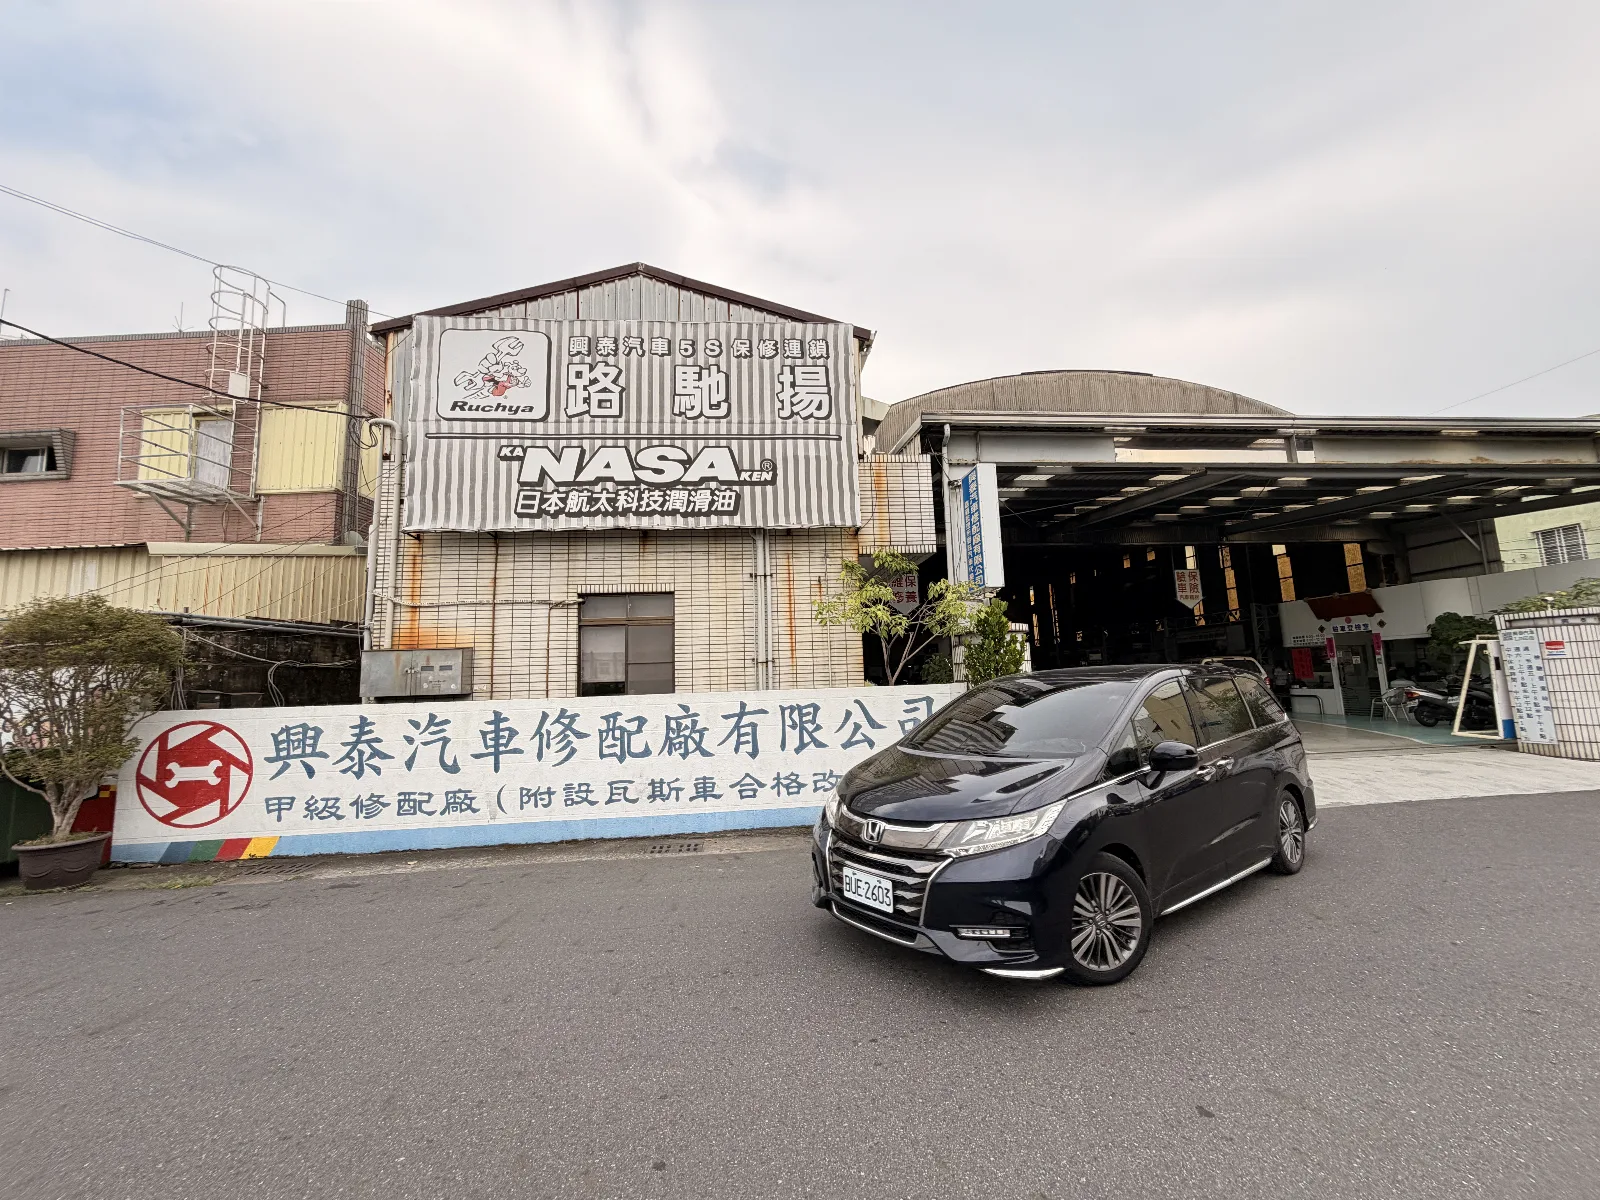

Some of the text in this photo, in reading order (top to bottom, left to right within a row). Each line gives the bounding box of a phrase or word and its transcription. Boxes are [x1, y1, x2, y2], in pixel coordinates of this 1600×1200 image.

[569, 336, 830, 359] 興泰汽車5S保修連鎖
[565, 361, 832, 420] 路馳揚
[450, 400, 535, 414] Ruchya
[515, 489, 737, 517] 日本航太科技潤滑油
[263, 695, 935, 781] 興泰汽車修配廠有限公司
[844, 874, 892, 907] BUE-2603
